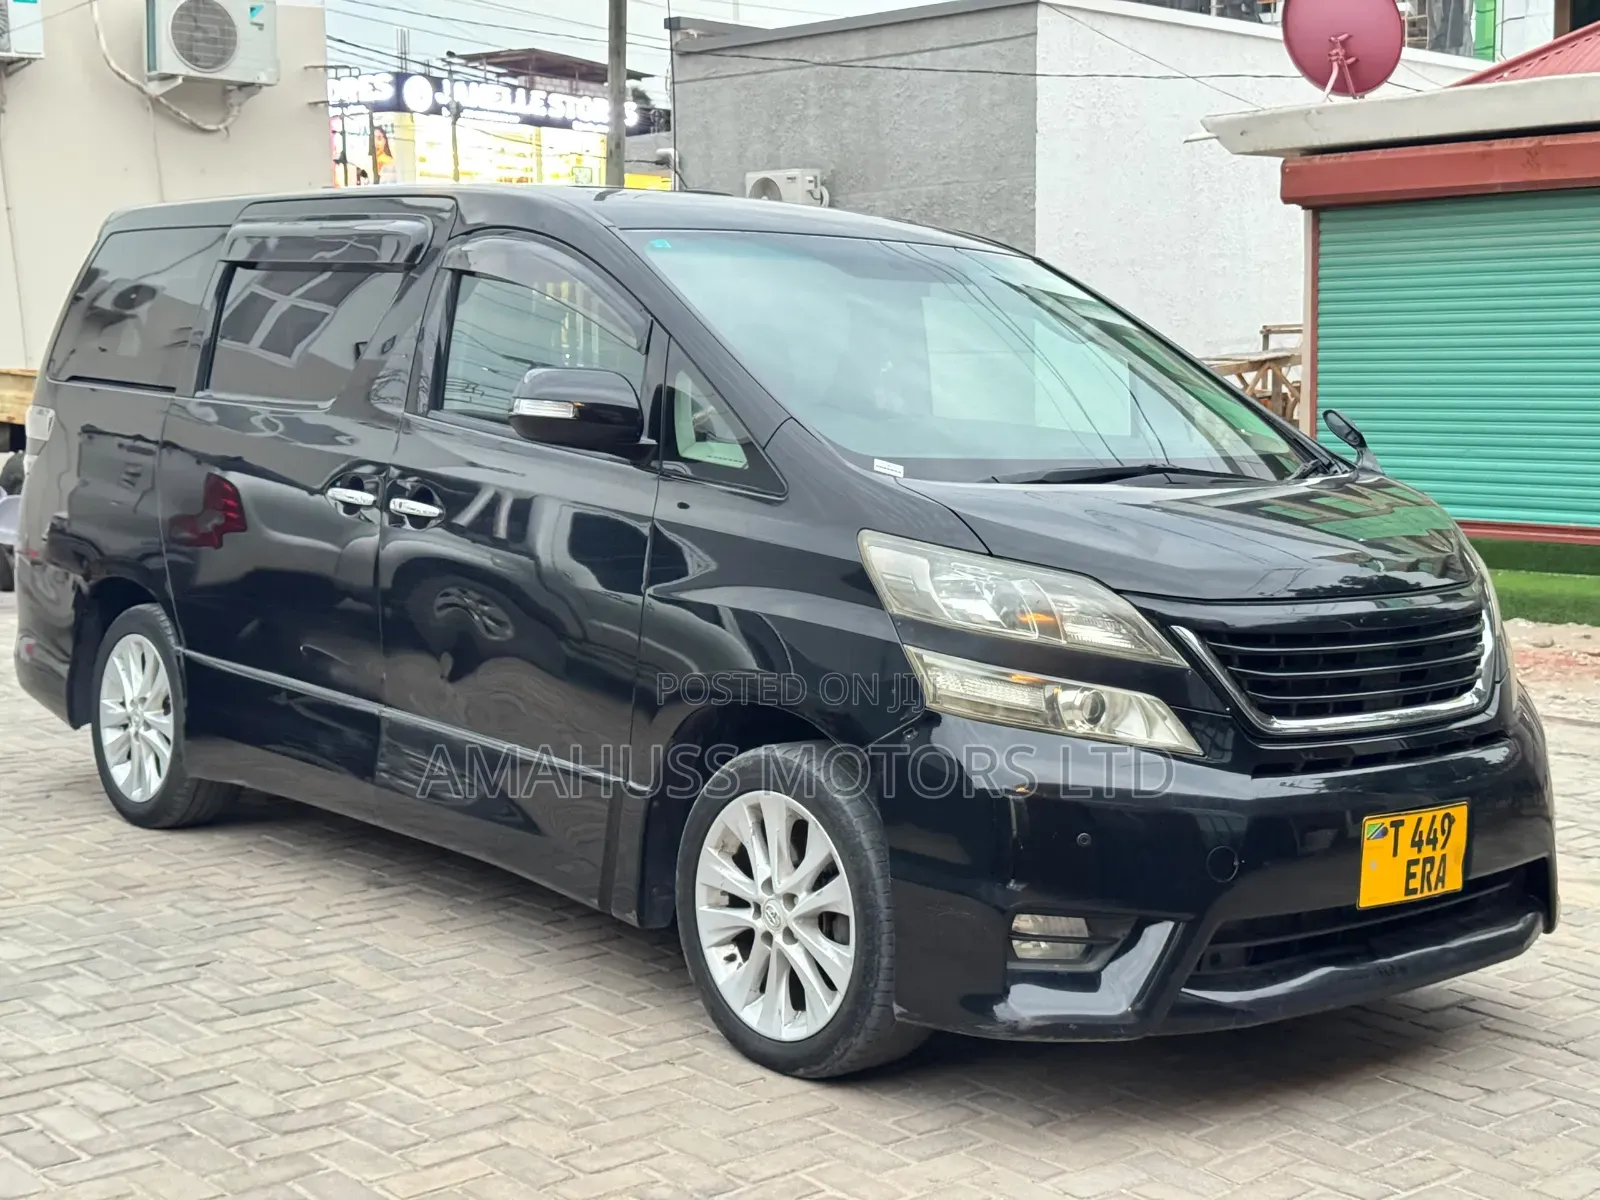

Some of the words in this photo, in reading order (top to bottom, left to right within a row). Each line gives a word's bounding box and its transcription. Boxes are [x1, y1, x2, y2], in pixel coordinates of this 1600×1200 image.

[547, 92, 638, 127] STORS
[1389, 819, 1405, 858] T
[1410, 812, 1455, 854] 449
[1404, 853, 1447, 897] ERA
